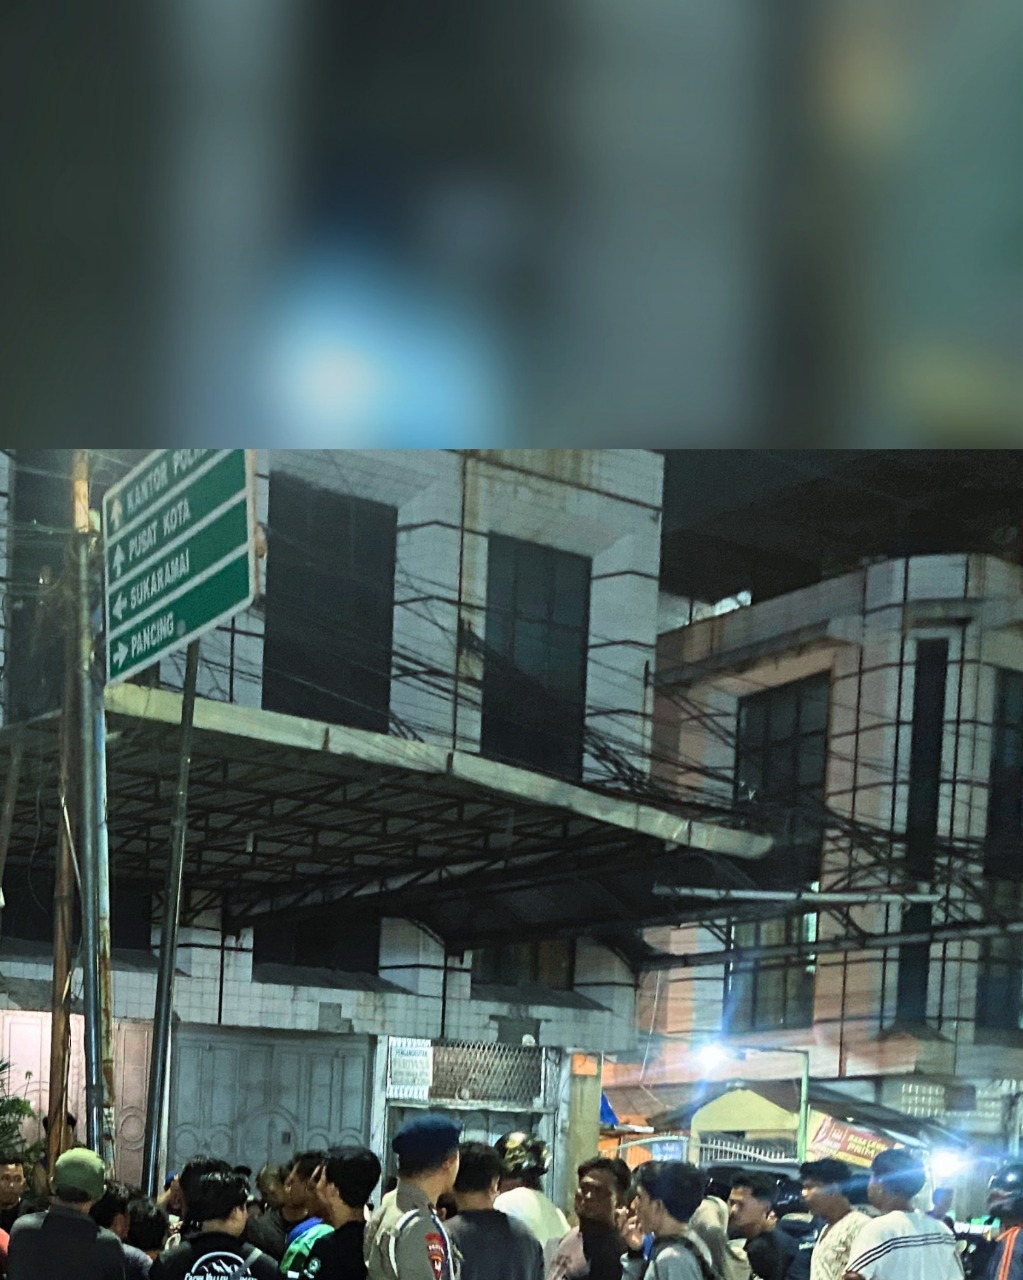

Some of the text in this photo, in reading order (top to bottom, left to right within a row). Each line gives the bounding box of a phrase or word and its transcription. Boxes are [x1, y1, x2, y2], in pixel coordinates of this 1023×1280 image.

[127, 461, 169, 512] KANTOR
[129, 497, 192, 561] PUSAT KOTA
[130, 548, 189, 609] SUKARAMAI
[131, 612, 174, 658] PANCING
